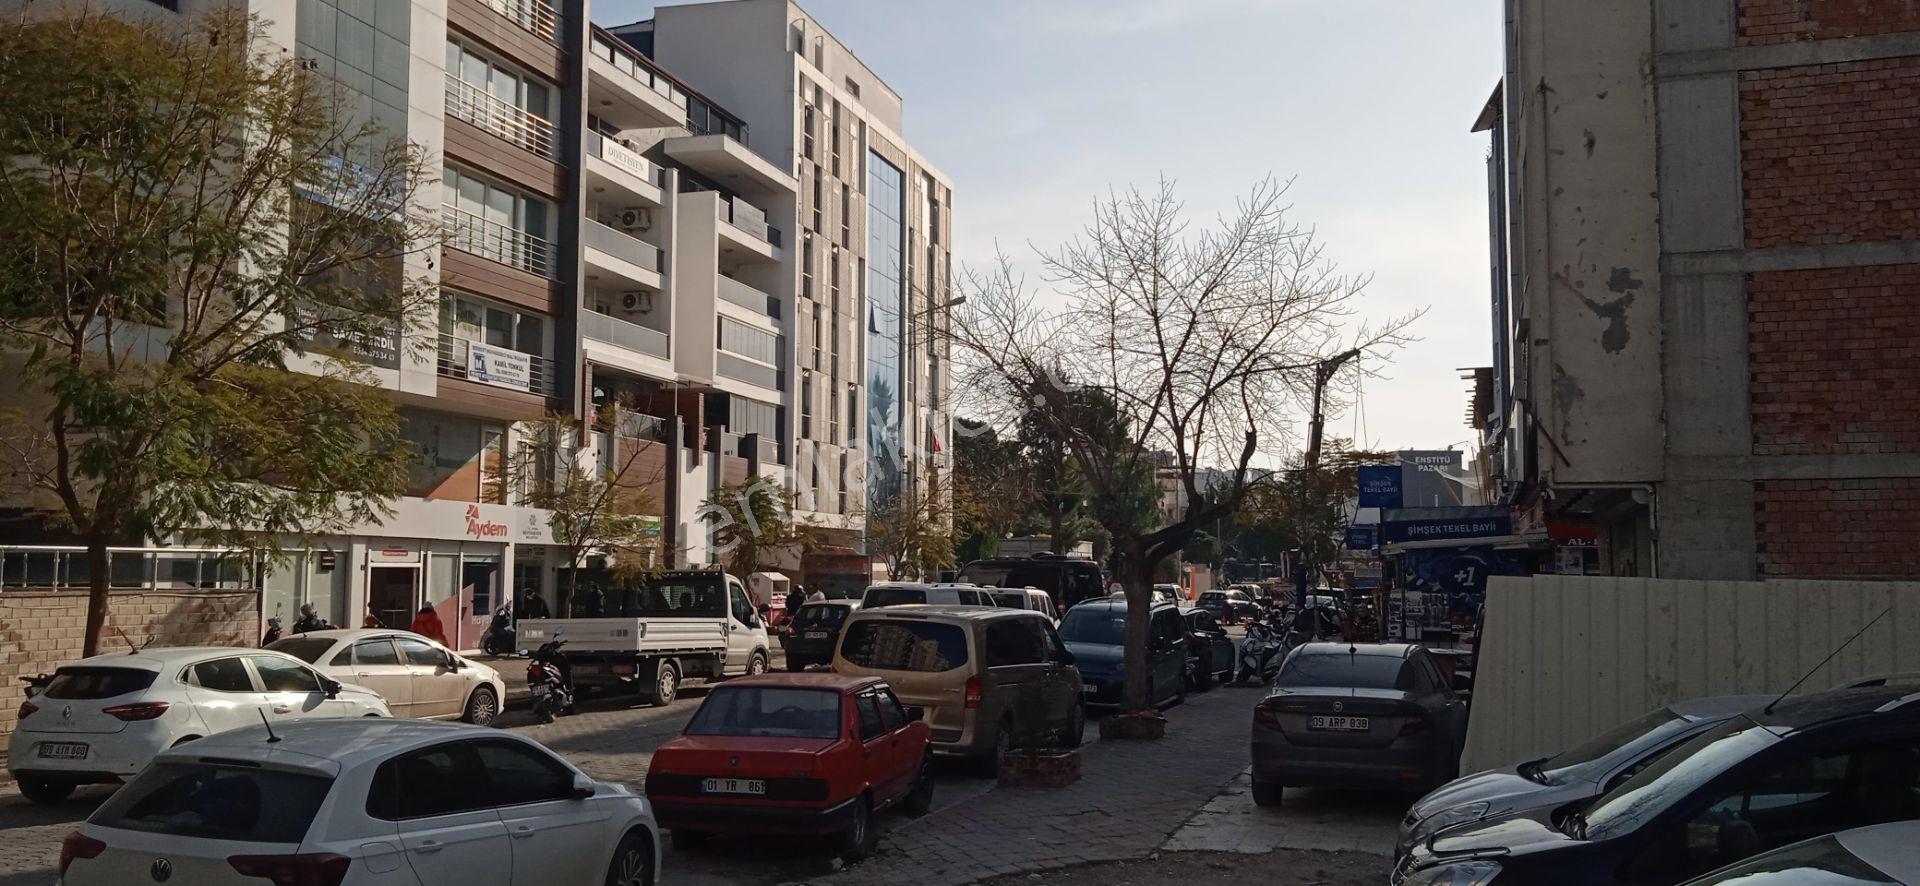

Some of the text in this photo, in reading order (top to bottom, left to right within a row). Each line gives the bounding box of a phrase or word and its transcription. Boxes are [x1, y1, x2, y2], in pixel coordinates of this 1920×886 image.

[1415, 455, 1450, 464] ENSTİTÜ
[466, 518, 508, 540] Aydem
[1407, 524, 1442, 536] ŞİMŞEK
[1444, 523, 1471, 533] TEKEL
[1454, 566, 1475, 587] +1
[1312, 717, 1324, 727] 09
[1329, 717, 1345, 728] ARP
[707, 780, 717, 790] 01
[725, 780, 737, 790] YR
